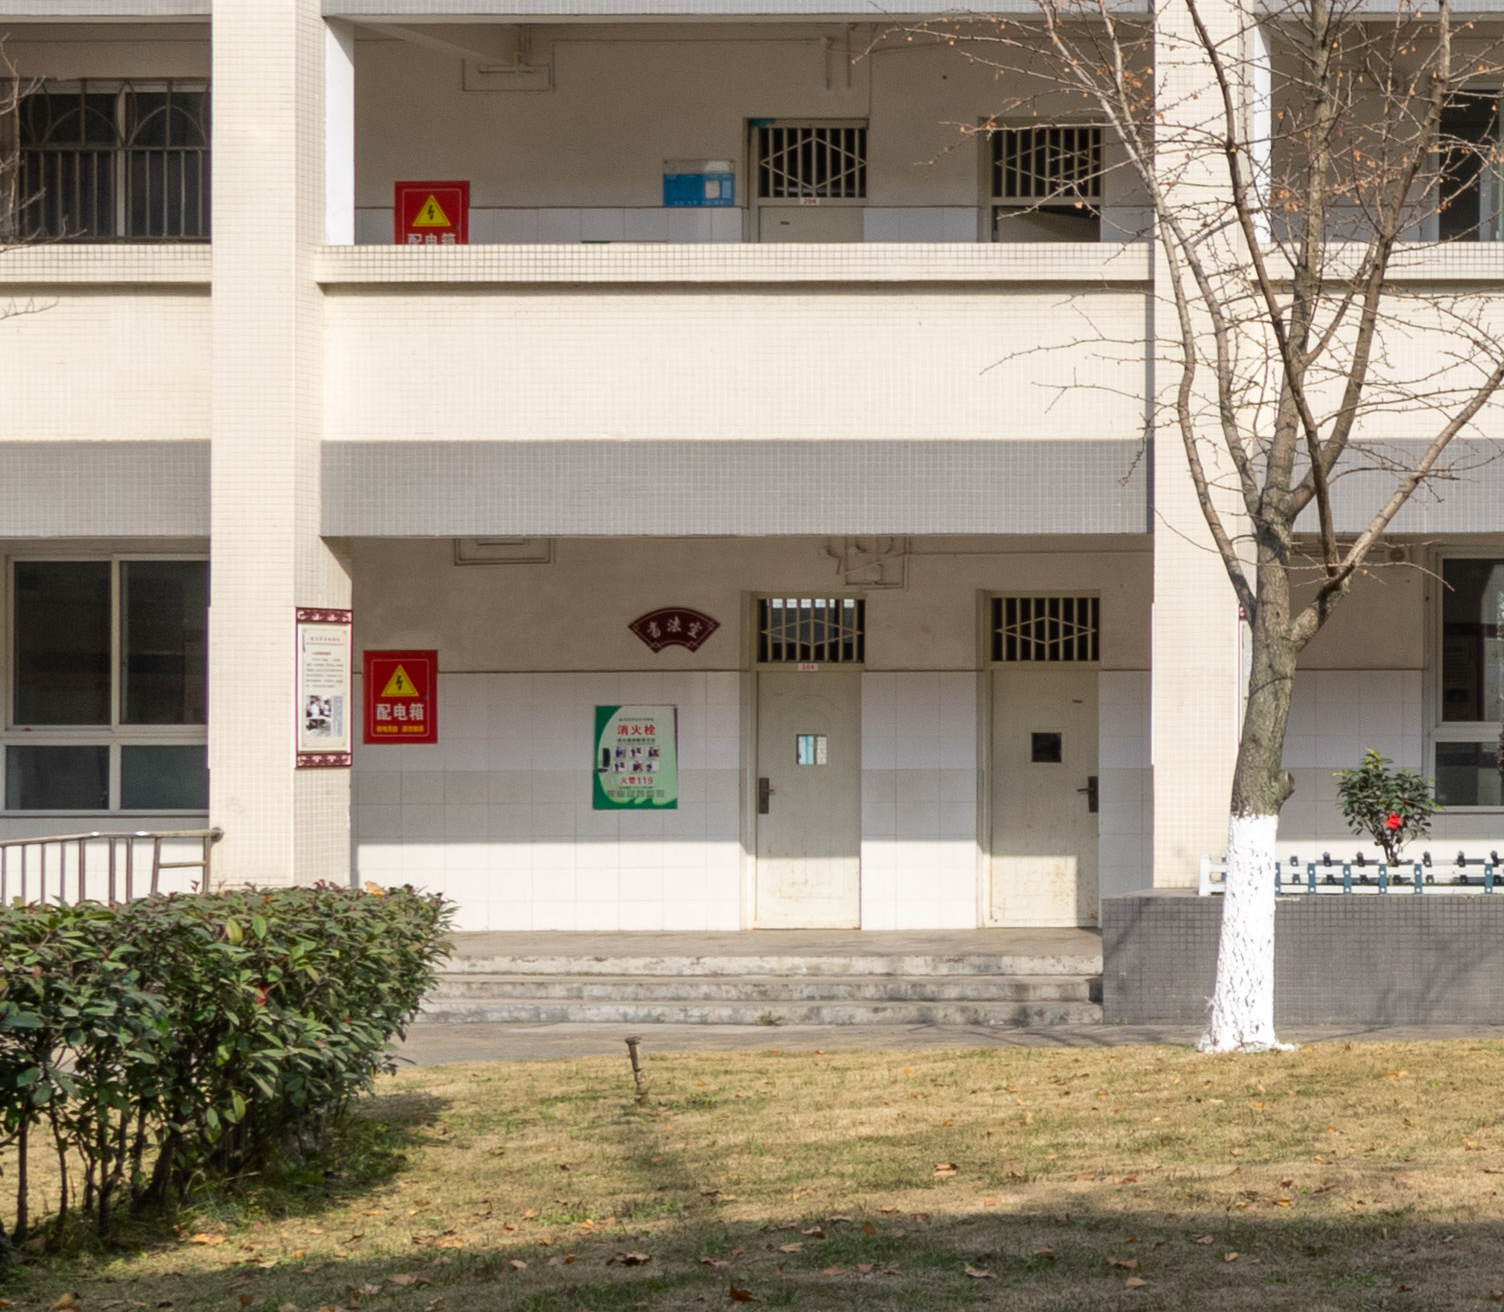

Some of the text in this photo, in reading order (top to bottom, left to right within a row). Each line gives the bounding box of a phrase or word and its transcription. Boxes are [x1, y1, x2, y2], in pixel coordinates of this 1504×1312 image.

[376, 703, 424, 721] 配电箱
[617, 724, 656, 735] 消火栓
